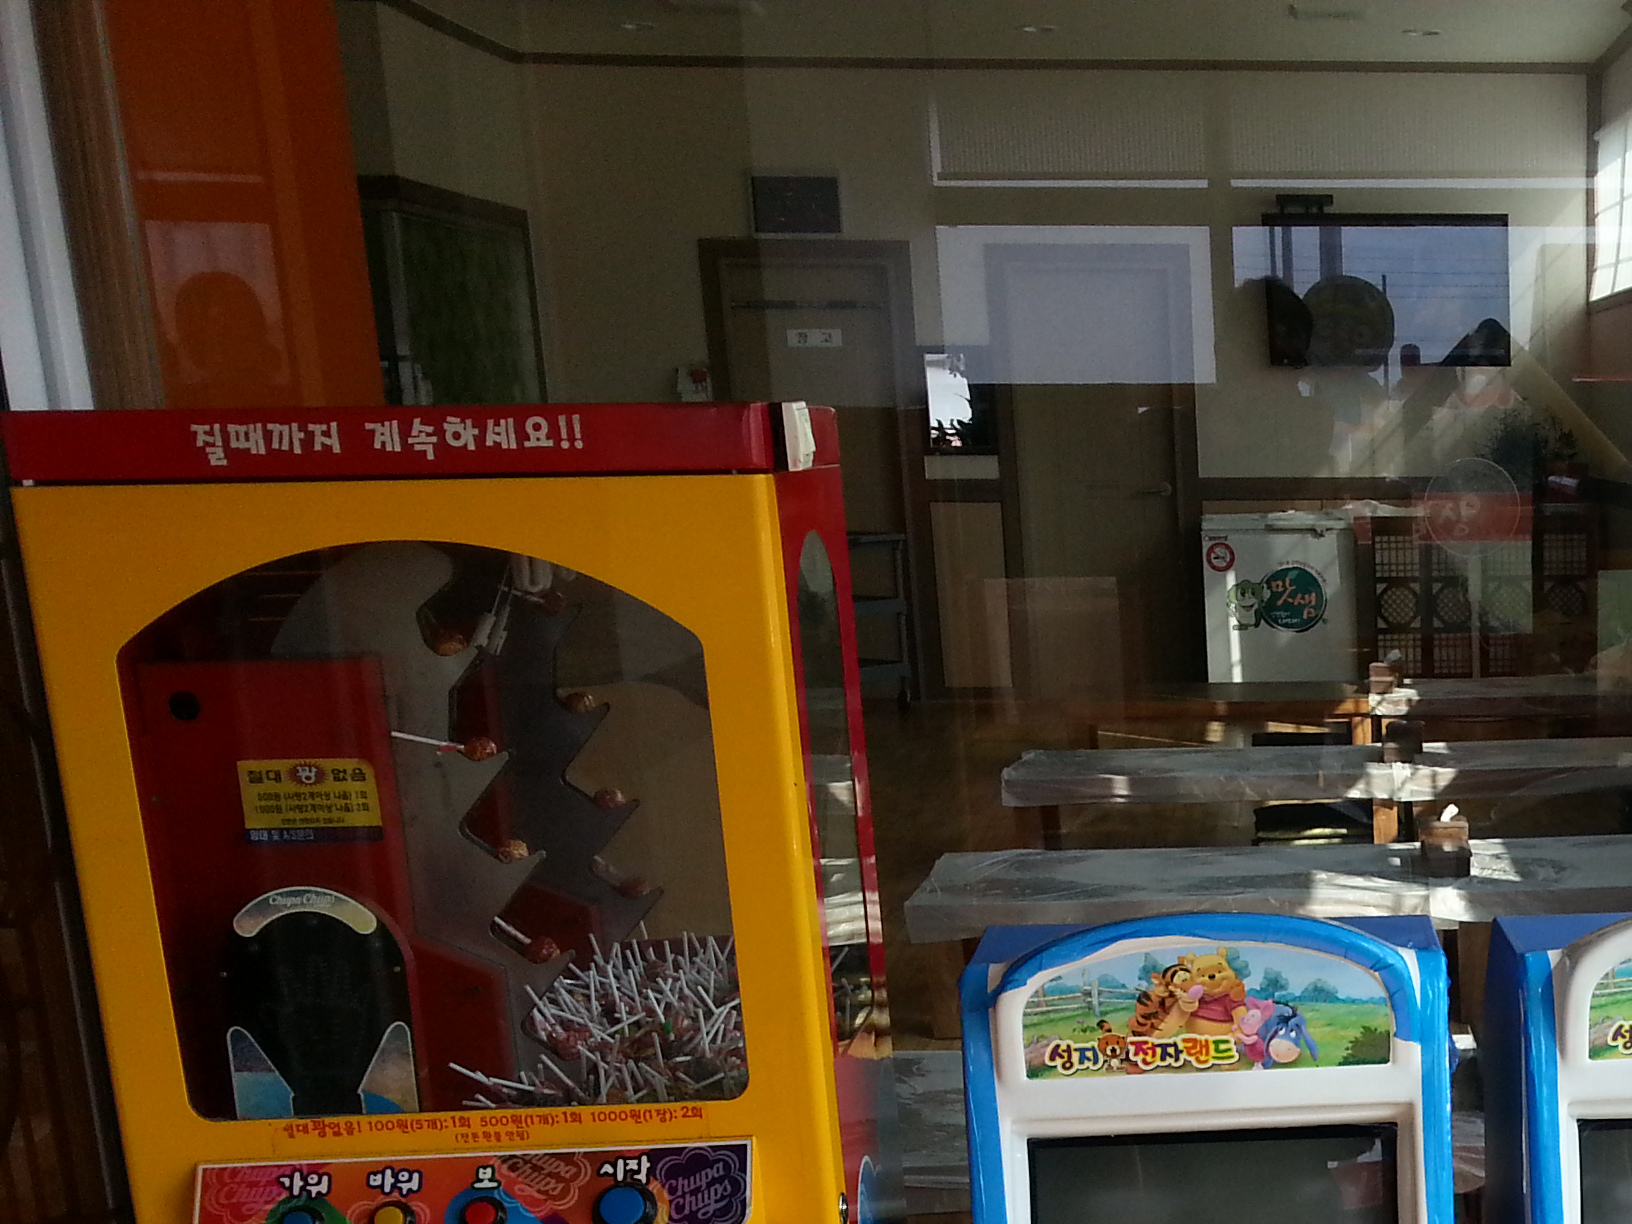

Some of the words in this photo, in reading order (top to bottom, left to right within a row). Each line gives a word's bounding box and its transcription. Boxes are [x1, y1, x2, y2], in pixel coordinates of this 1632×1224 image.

[190, 421, 342, 466] 질때까지
[364, 414, 583, 460] 계속하세요!!
[248, 769, 282, 784] 절대
[296, 766, 318, 784] 꽝
[331, 767, 367, 782] 없음
[1048, 1039, 1099, 1072] 성지
[1128, 1037, 1239, 1069] 전자랜드
[279, 1171, 329, 1198] 가위
[369, 1168, 420, 1195] 바위
[471, 1167, 500, 1189] 보
[600, 1155, 650, 1184] 시작
[664, 1161, 727, 1199] Chupa
[669, 1179, 732, 1220] Chups
